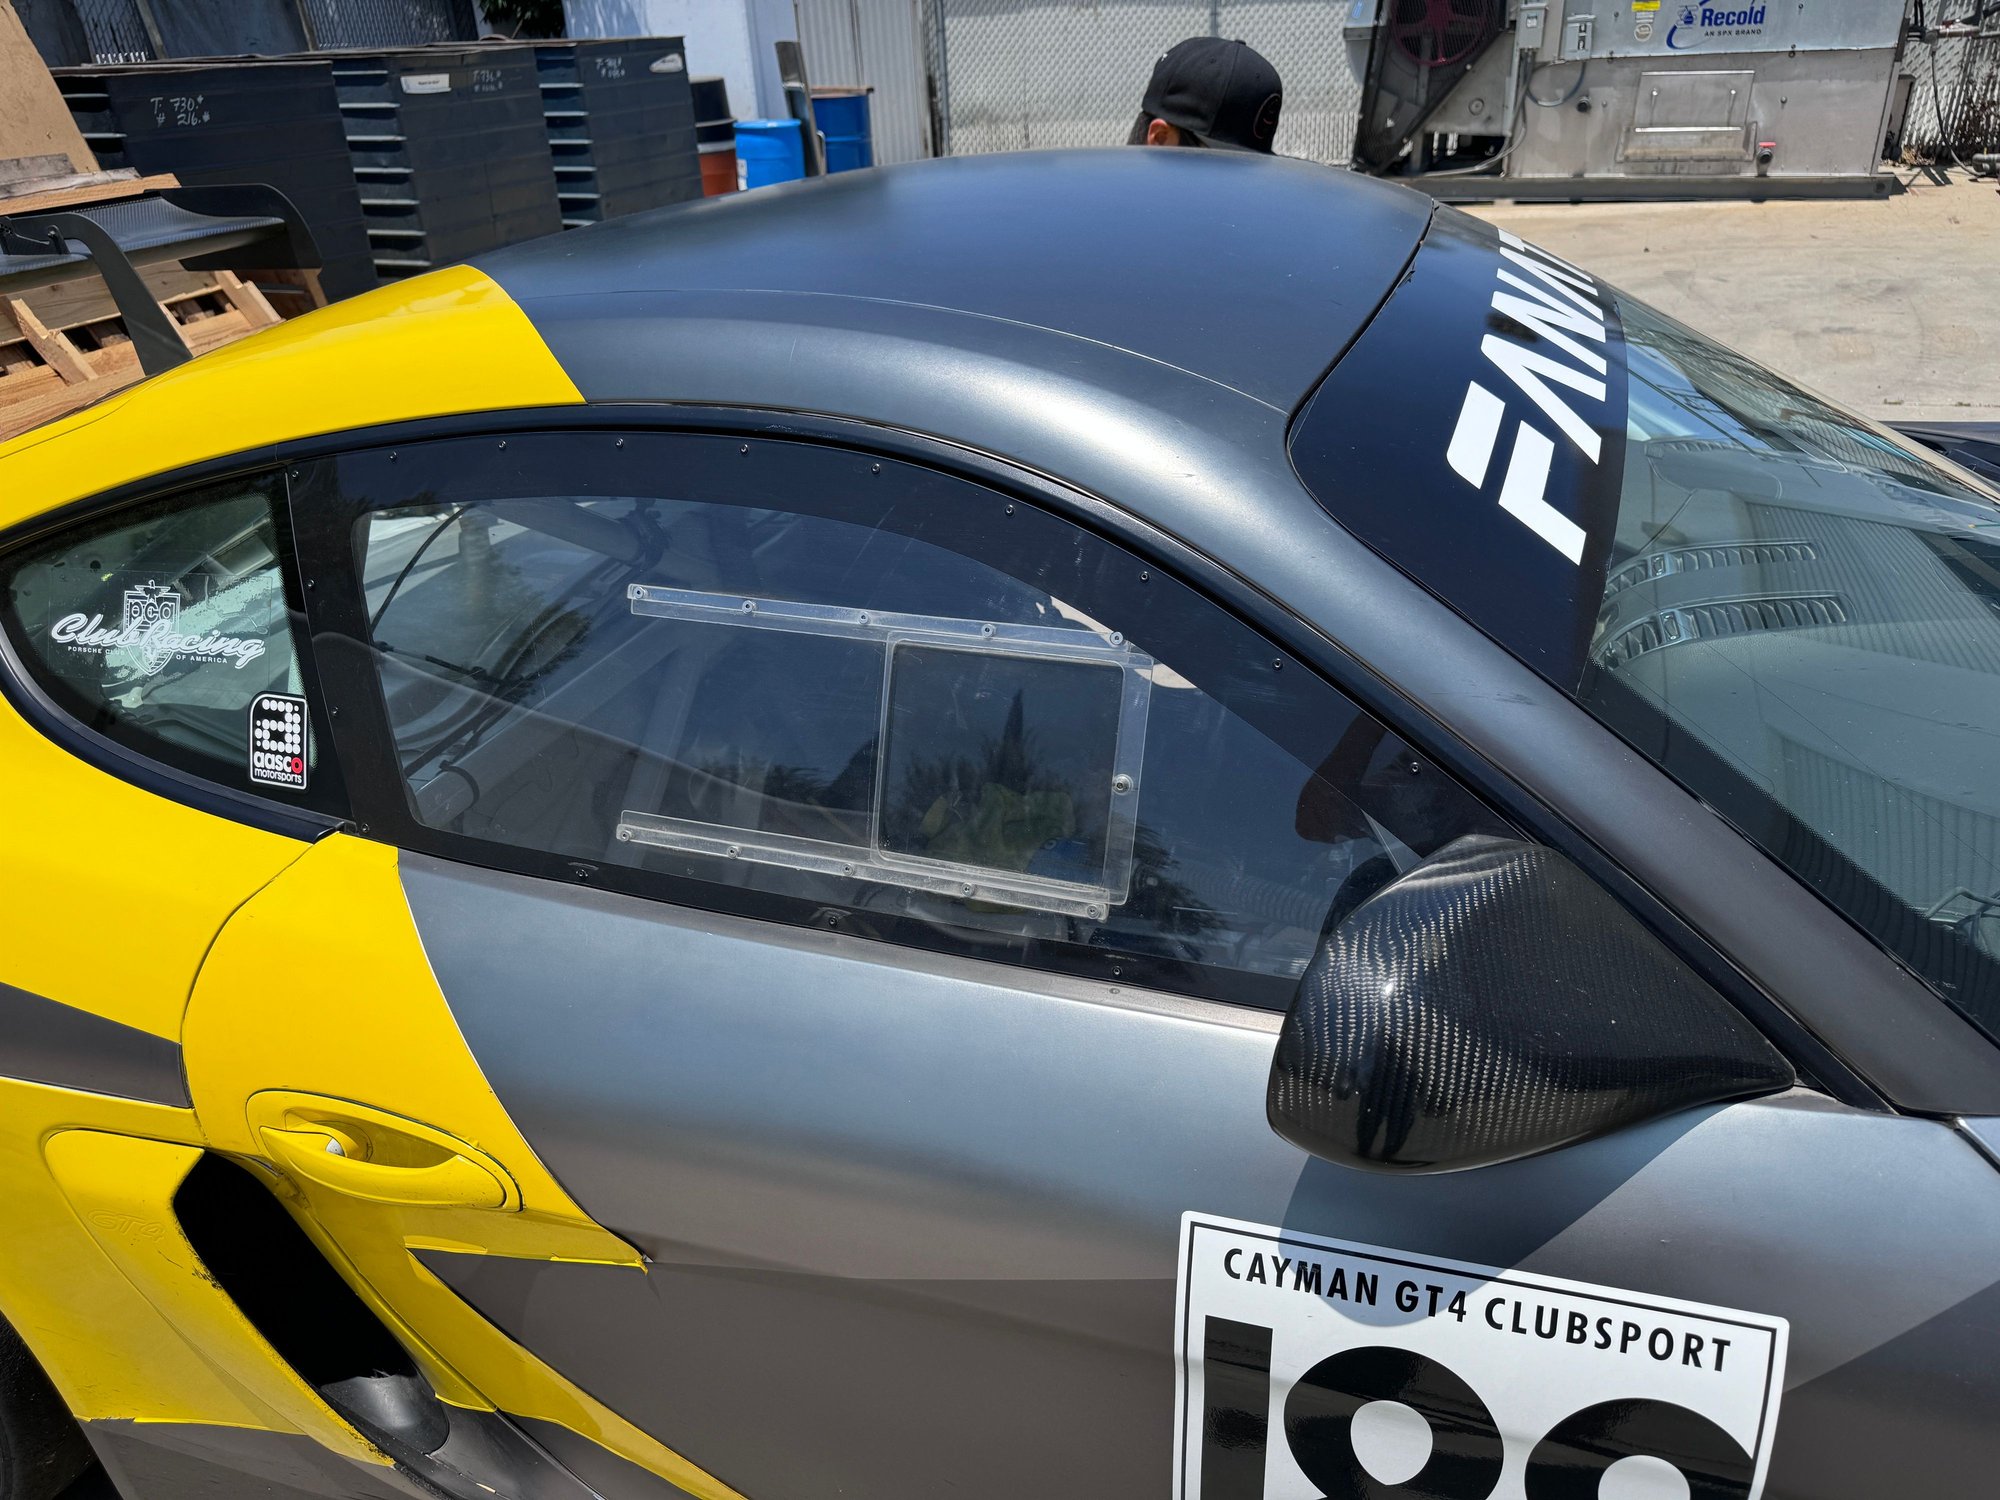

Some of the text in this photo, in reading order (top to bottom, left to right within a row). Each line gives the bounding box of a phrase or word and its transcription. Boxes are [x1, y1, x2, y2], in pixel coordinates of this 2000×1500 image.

[1701, 5, 1766, 27] Recold
[51, 613, 266, 669] Club Racing
[67, 645, 103, 654] PORSCHE
[190, 655, 228, 664] AMERICA
[253, 750, 303, 774] aasco
[254, 767, 302, 783] motorsports
[87, 1208, 165, 1243] GT4
[1223, 1247, 1731, 1372] CAYMAN GT4 CLUBSPORT
